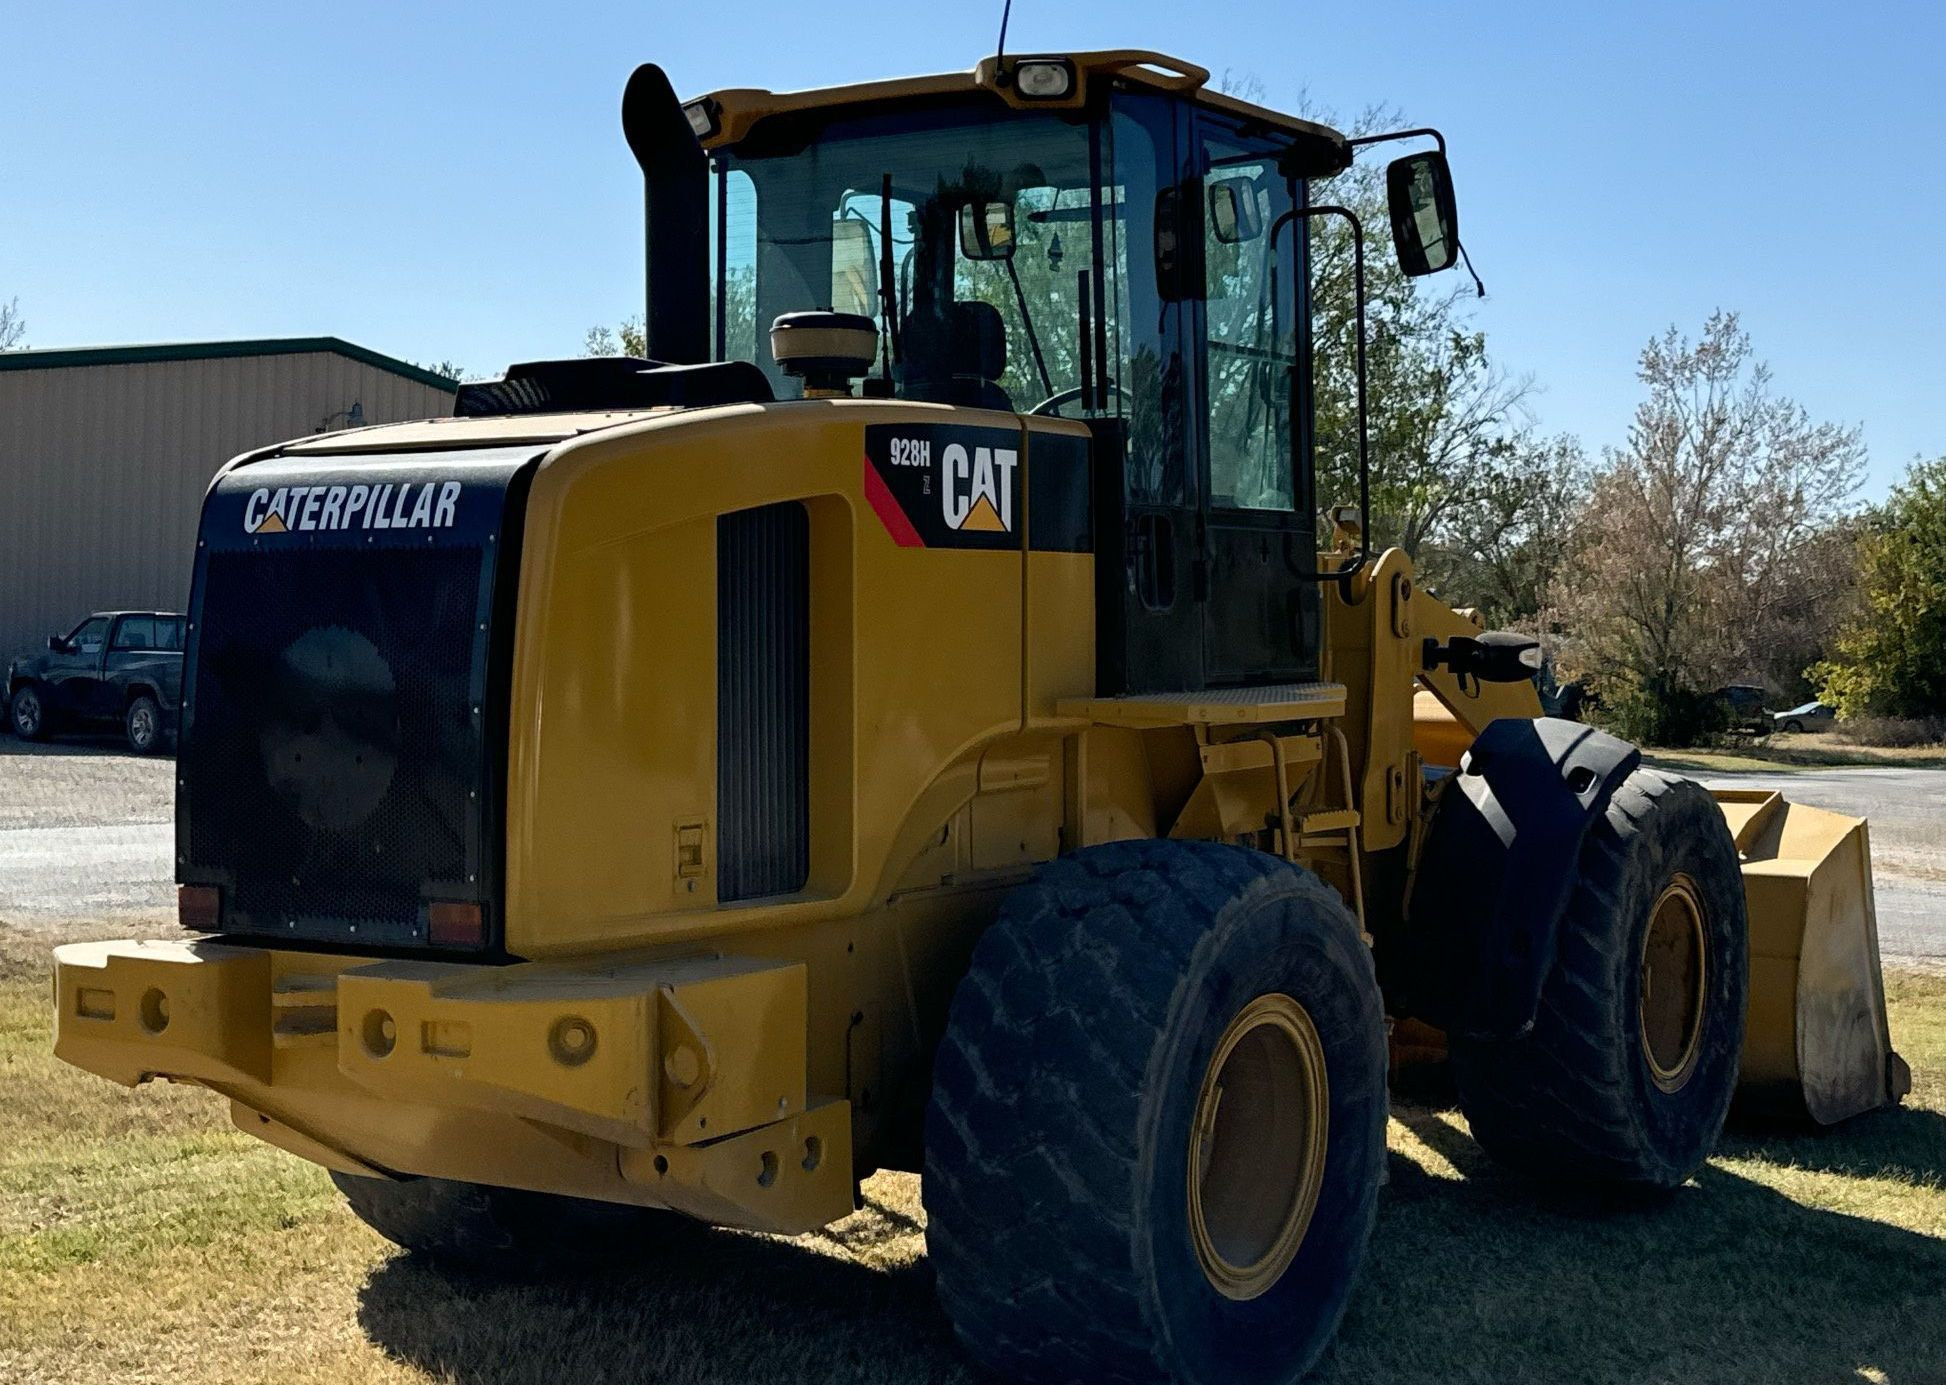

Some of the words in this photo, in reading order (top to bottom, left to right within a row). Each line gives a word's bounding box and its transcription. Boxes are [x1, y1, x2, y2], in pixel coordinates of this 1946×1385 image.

[890, 437, 931, 467] 928H
[244, 481, 462, 533] CATERPILLAR
[942, 443, 1018, 533] CAT
